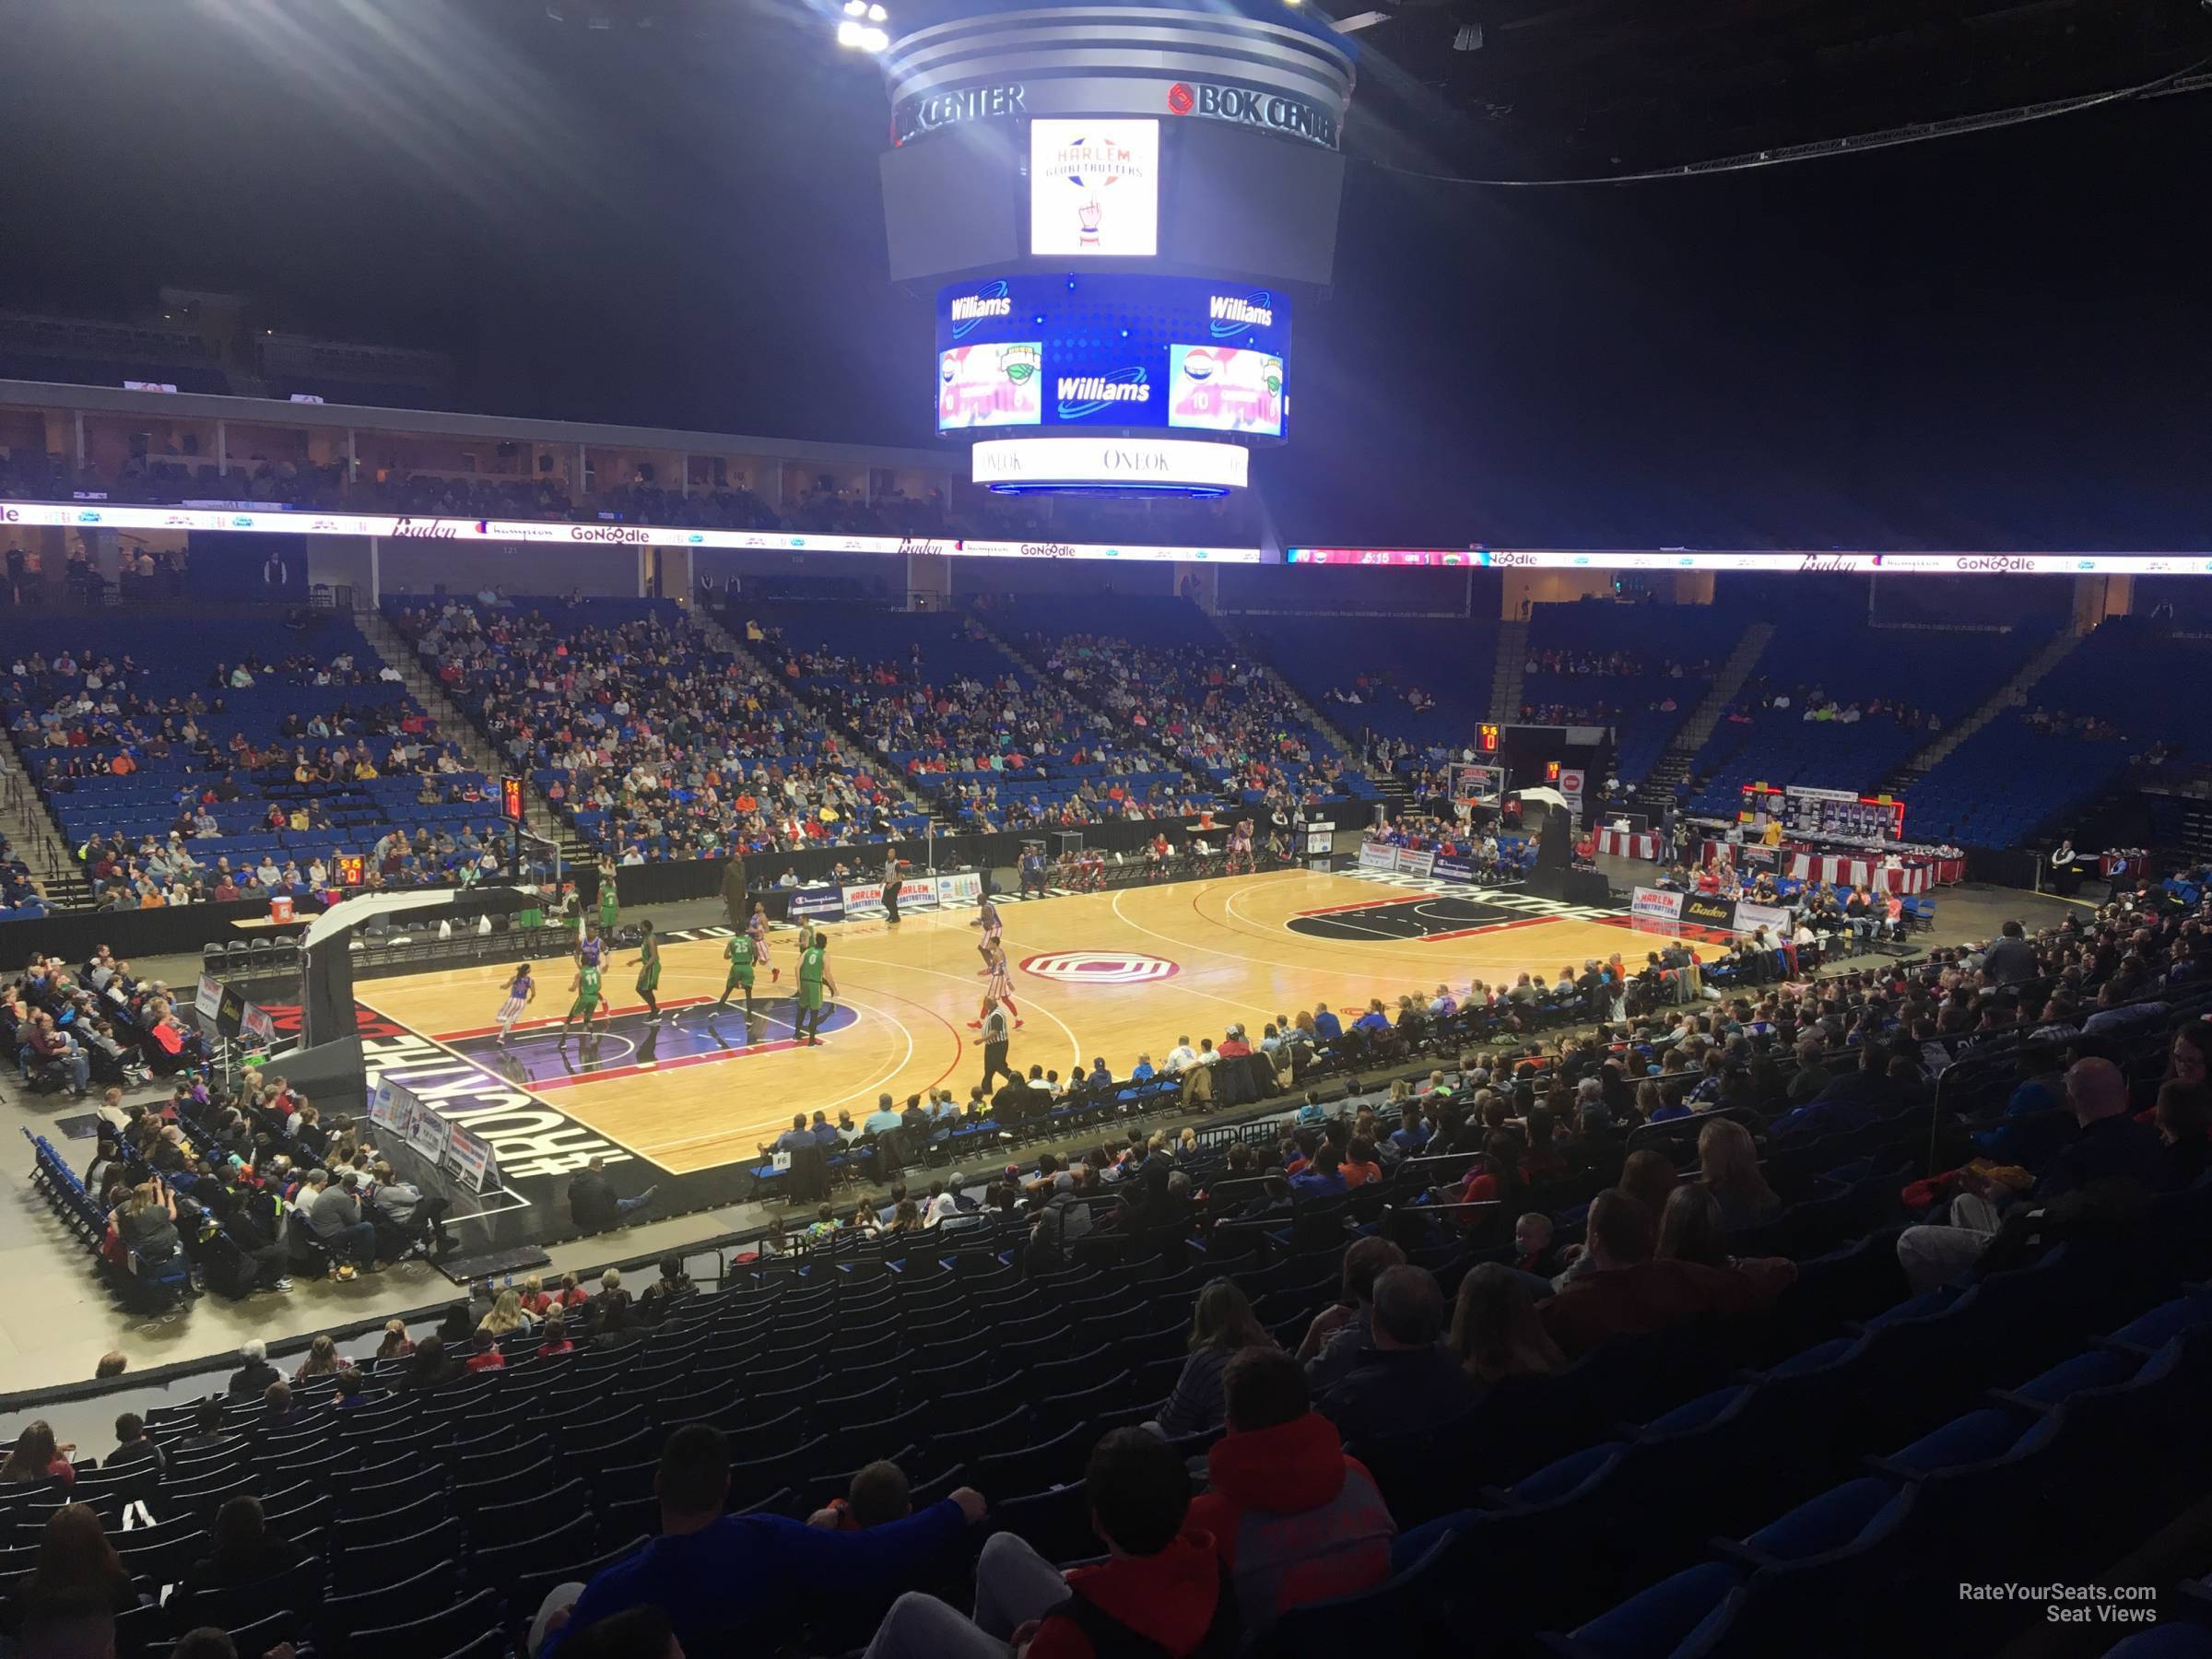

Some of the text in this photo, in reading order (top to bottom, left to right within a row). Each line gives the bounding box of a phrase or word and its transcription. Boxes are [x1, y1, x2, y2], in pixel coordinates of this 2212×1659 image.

[924, 82, 1027, 129] CENTER
[1197, 85, 1263, 124] BOK
[1057, 147, 1131, 162] HARLEM
[951, 295, 1011, 321] Williams
[1210, 296, 1272, 326] Williams
[1058, 377, 1150, 402] Williams
[1103, 449, 1169, 471] ONEOK
[391, 518, 456, 538] Baden
[571, 526, 649, 545] GoNoodle
[898, 538, 942, 555] Baden
[1021, 542, 1076, 558] GoNoodle
[1957, 554, 2035, 573] GoNoodle
[1487, 735, 1494, 749] 0
[347, 869, 356, 882] 0
[795, 891, 837, 904] Champion
[851, 890, 882, 901] HARLEM
[1641, 894, 1674, 907] HARLEM
[1688, 902, 1727, 920] Baden
[735, 942, 748, 953] 25
[808, 953, 817, 965] 0
[777, 1157, 787, 1165] F6
